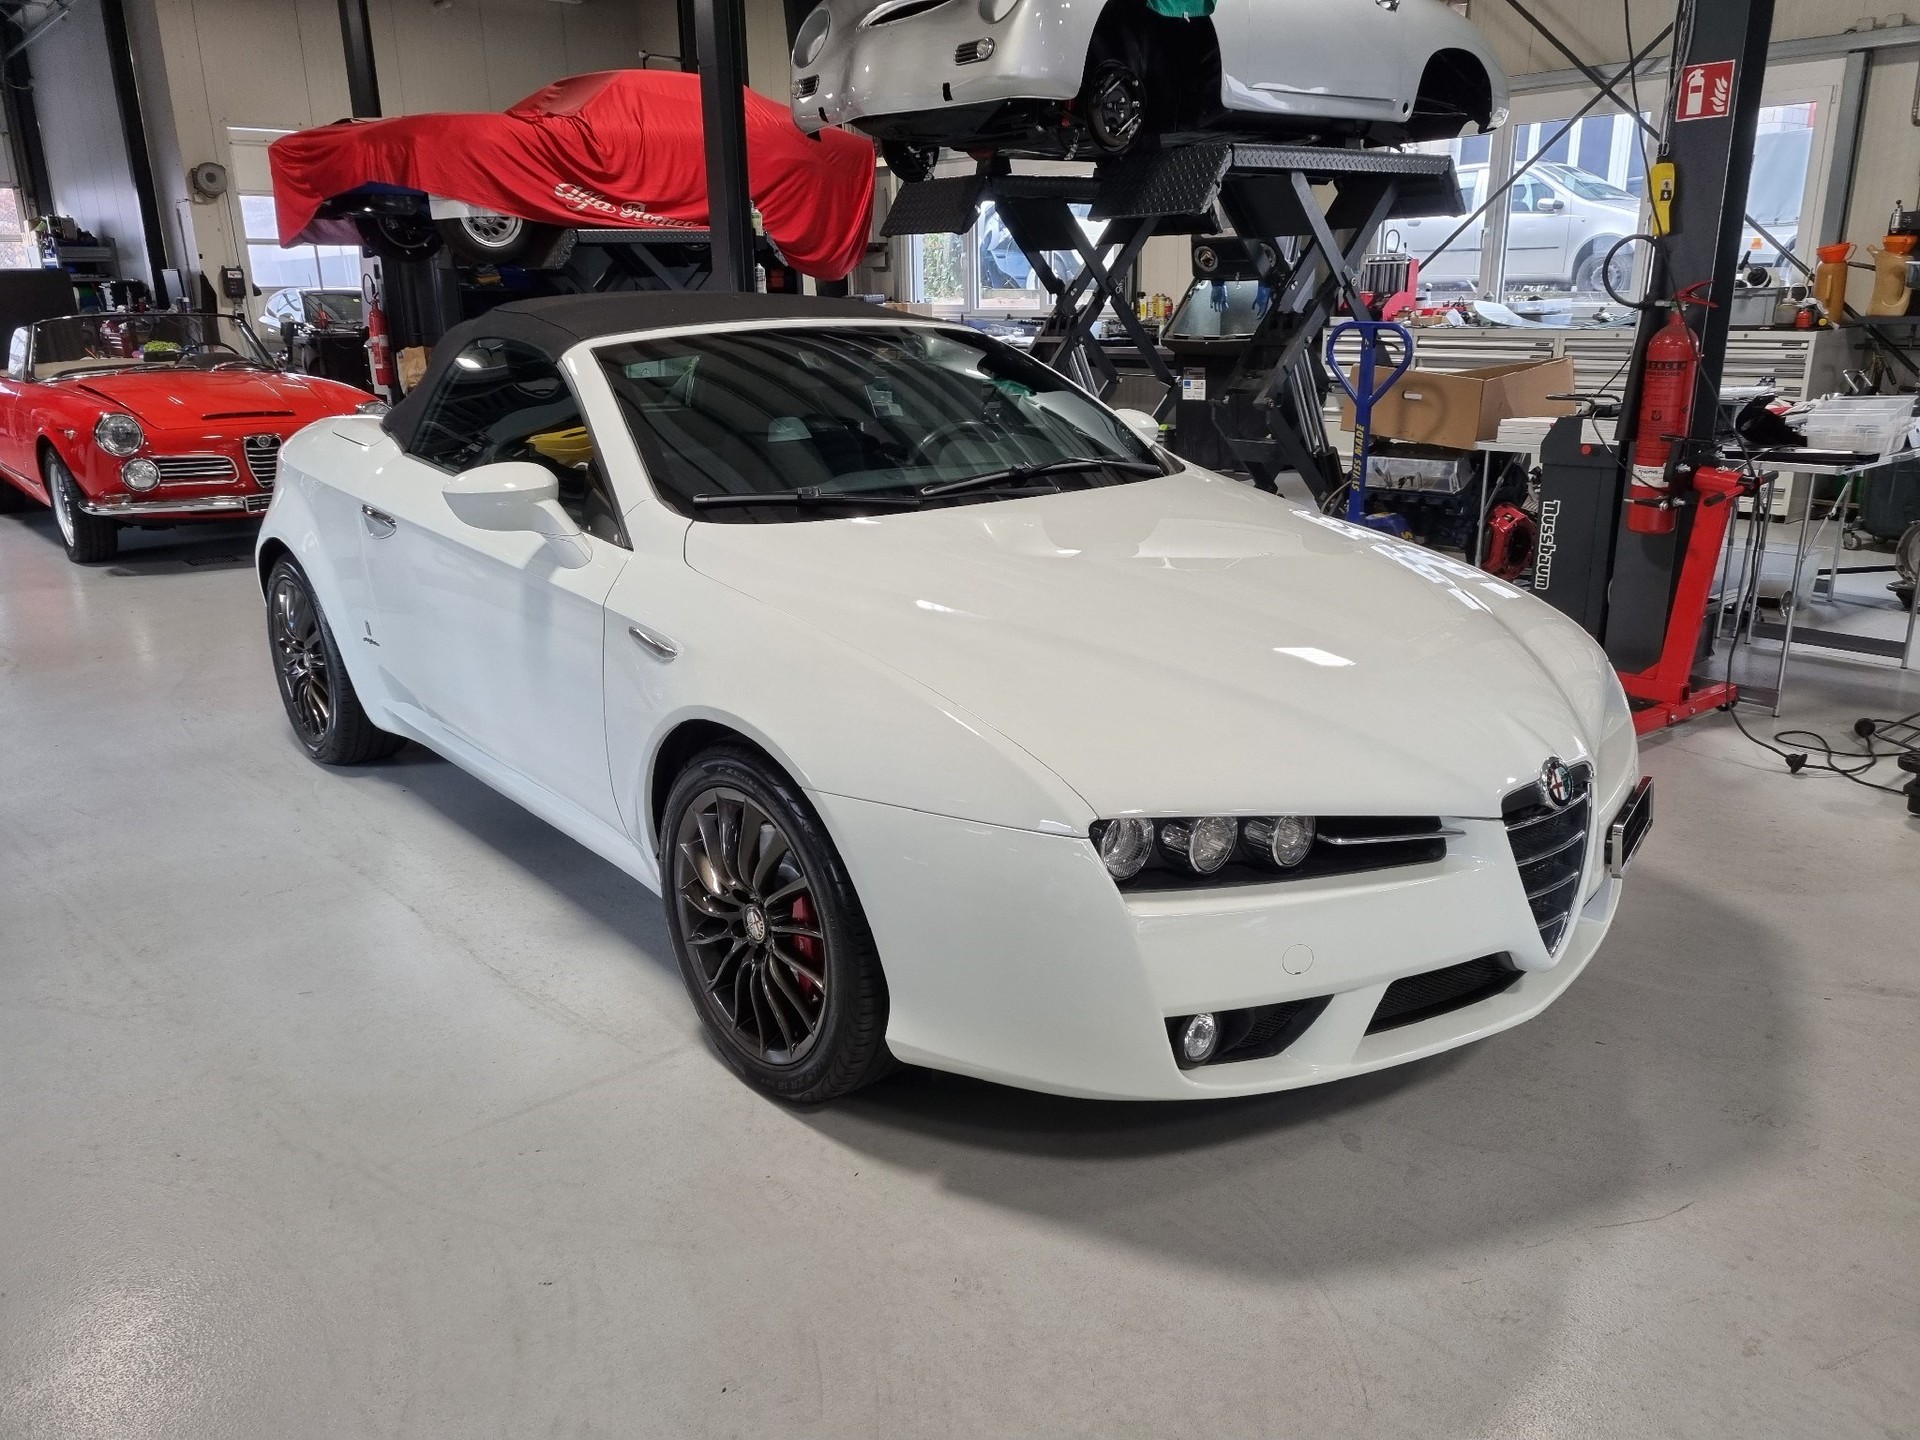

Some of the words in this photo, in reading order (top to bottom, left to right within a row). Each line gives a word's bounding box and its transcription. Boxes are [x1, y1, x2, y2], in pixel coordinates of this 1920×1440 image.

[555, 183, 616, 213] Alfa
[619, 202, 699, 227] Romeo
[1355, 424, 1365, 456] MADE
[1534, 500, 1560, 590] Nussbaum
